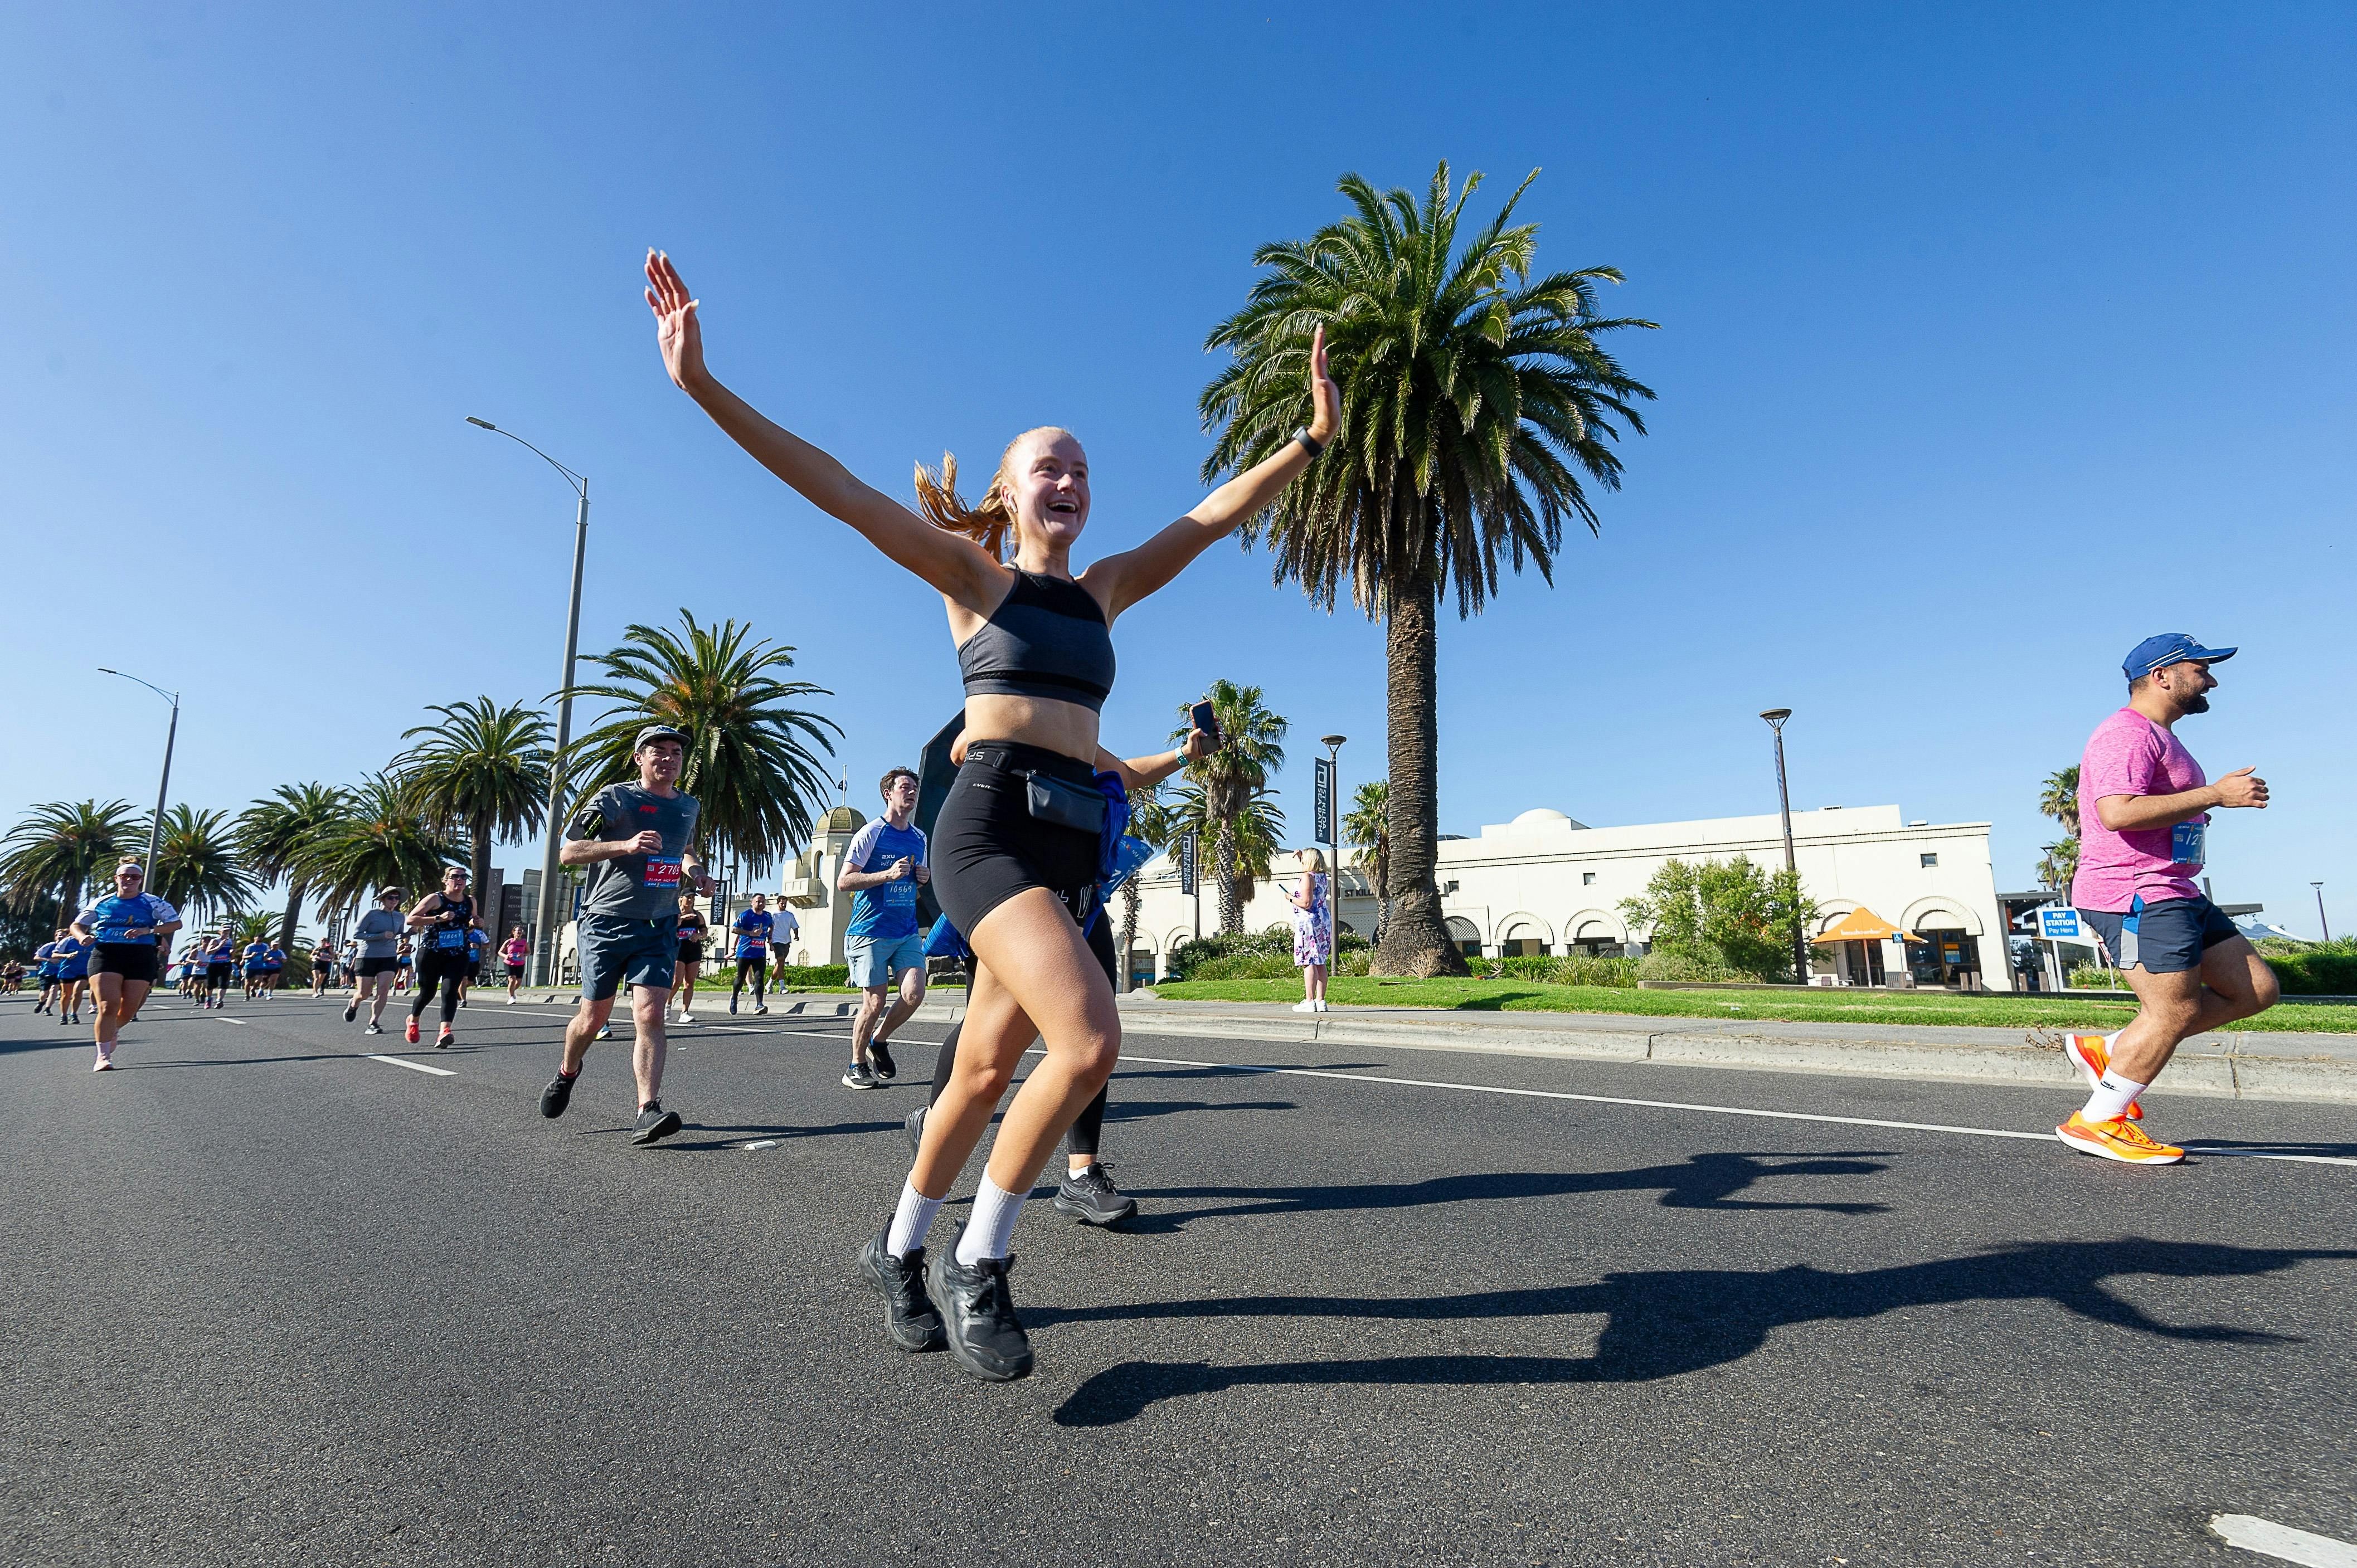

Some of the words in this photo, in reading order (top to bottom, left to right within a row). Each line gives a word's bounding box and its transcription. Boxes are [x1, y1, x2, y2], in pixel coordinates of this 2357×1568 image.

[1322, 788, 1326, 801] ST
[1187, 854, 1190, 862] ST
[658, 865, 680, 875] 2705
[494, 872, 498, 883] ST
[890, 885, 912, 893] 10569
